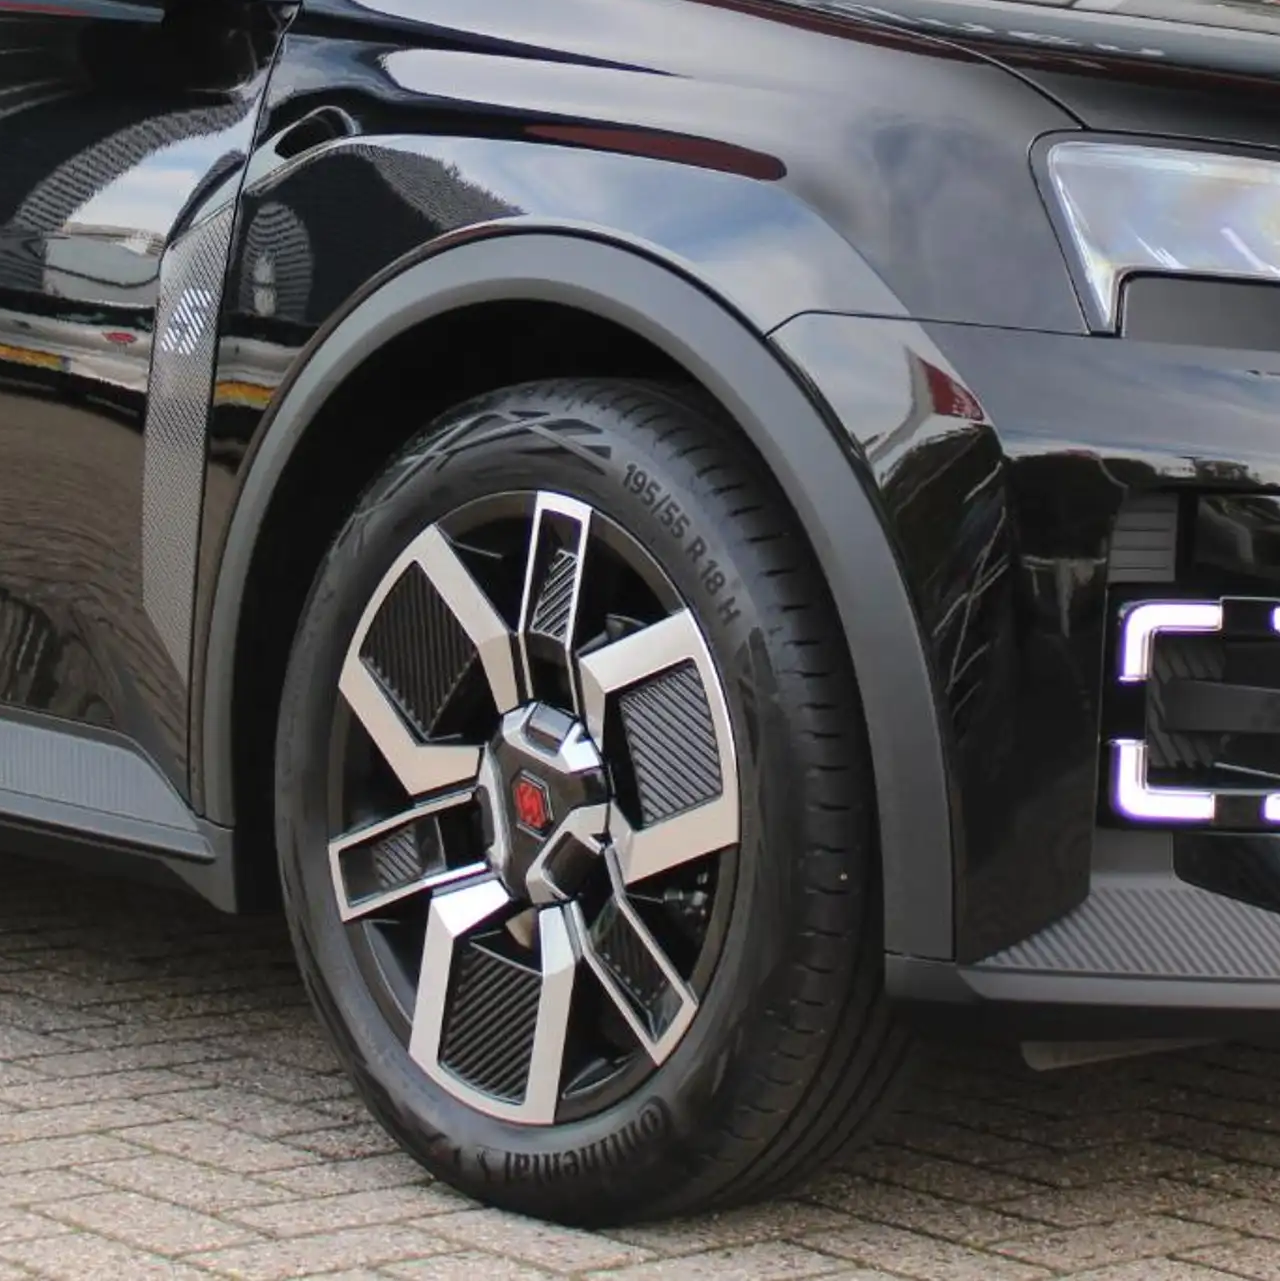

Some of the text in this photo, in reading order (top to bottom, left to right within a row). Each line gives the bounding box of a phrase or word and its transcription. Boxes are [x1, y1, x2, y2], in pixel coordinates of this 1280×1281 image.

[620, 463, 741, 626] 195/55 R 18 H
